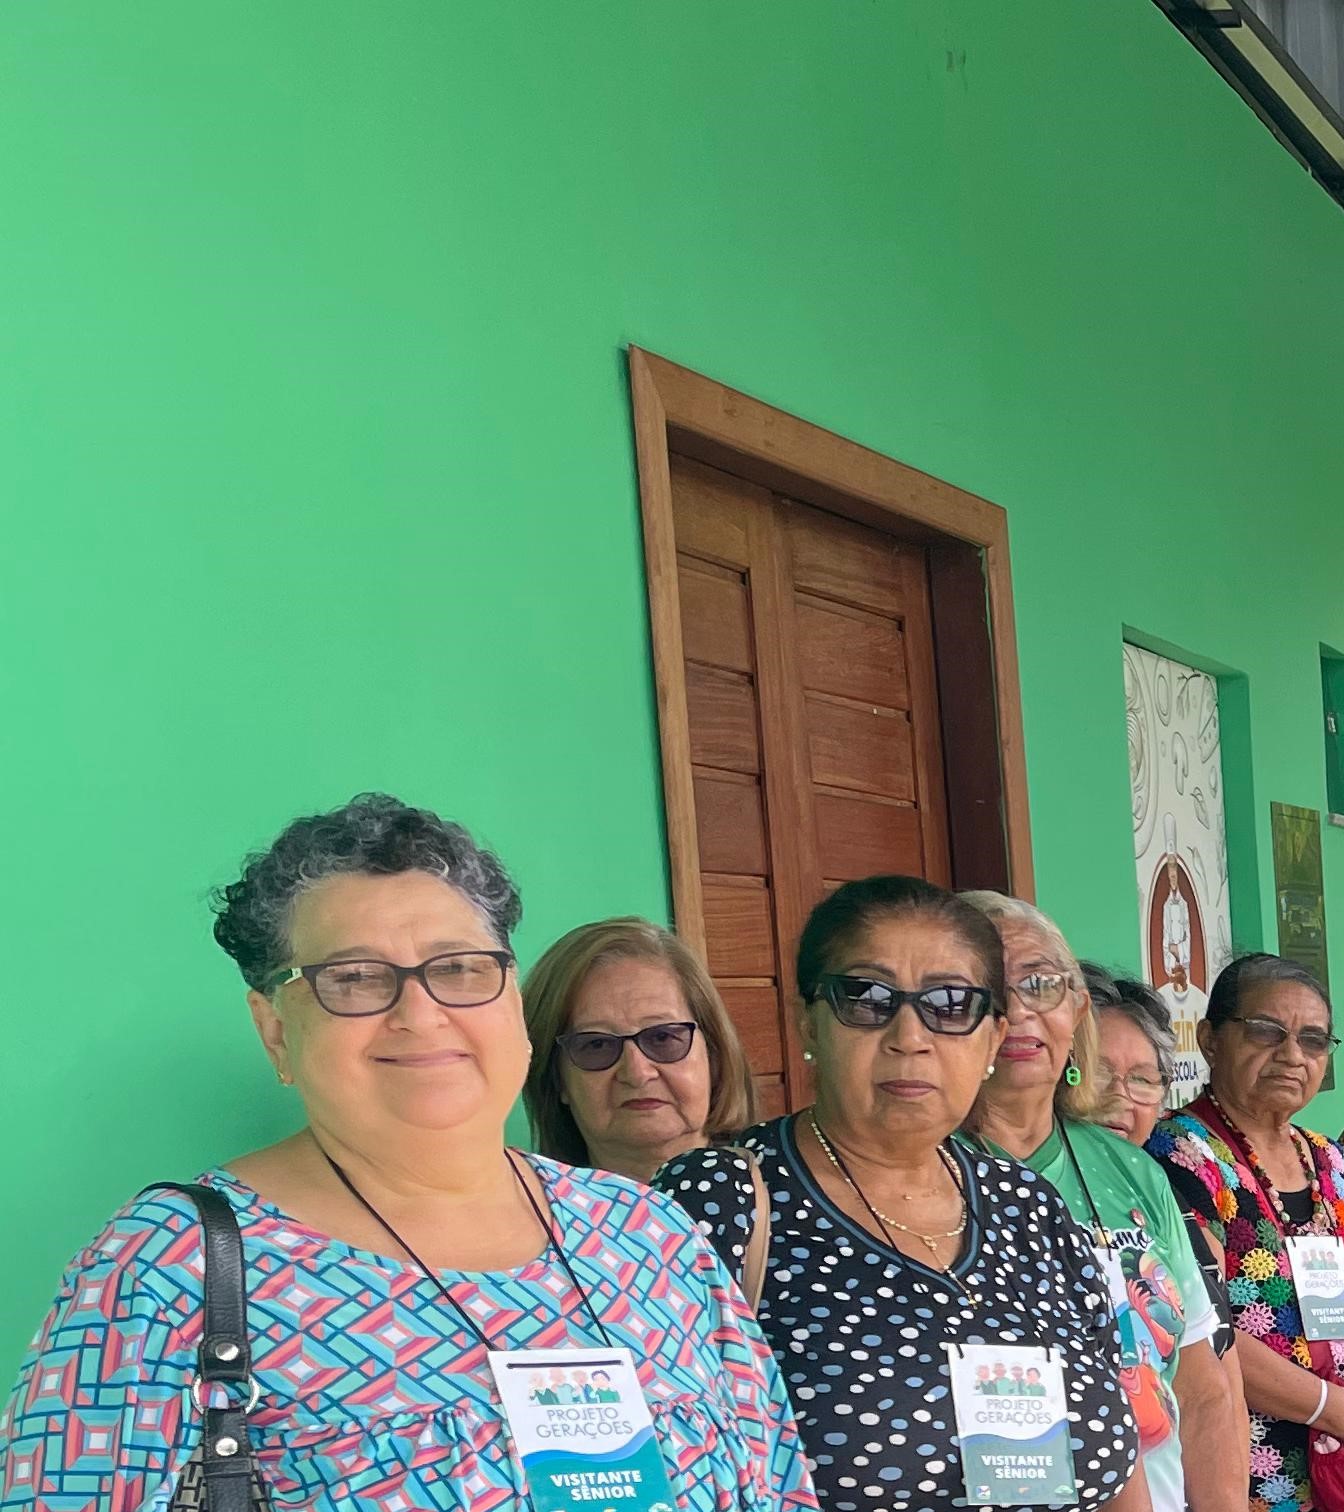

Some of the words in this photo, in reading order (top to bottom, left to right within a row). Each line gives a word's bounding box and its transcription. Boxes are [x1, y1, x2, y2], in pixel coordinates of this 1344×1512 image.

[1173, 1060, 1199, 1081] SCOLA
[986, 1398, 1043, 1411] PROJETO
[546, 1407, 619, 1423] PROJETO
[981, 1455, 1054, 1467] VISITANTE
[550, 1470, 642, 1487] VISITANTE
[995, 1465, 1047, 1479] SÊNIOR
[570, 1485, 637, 1501] SÊNIOR
